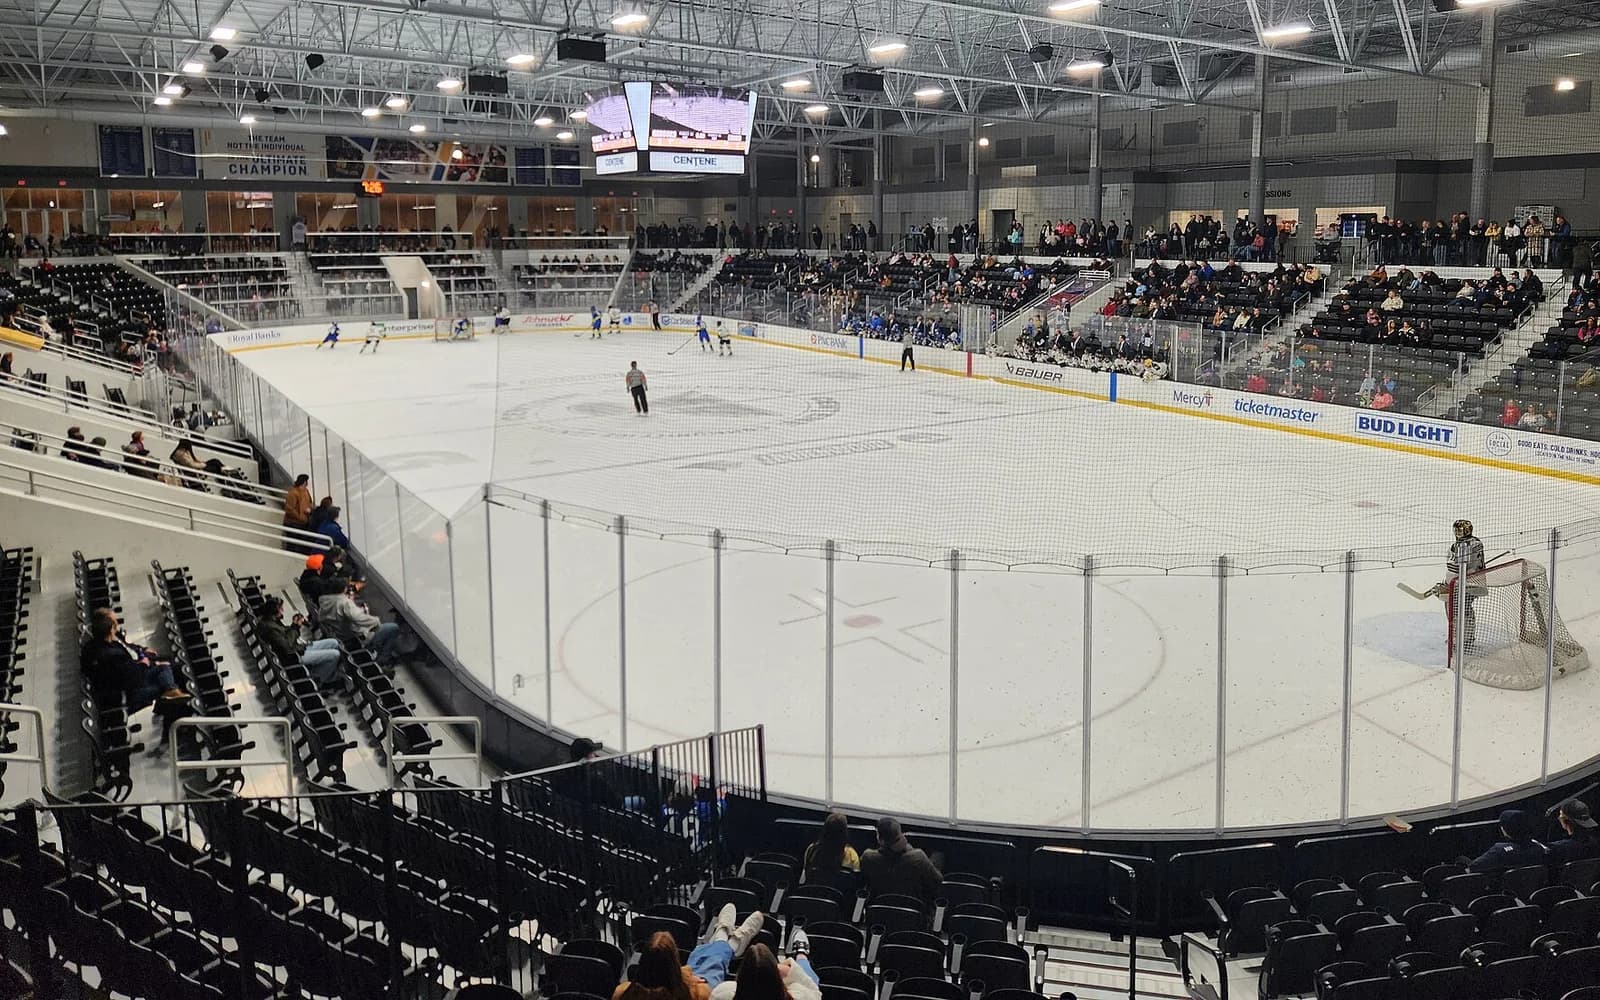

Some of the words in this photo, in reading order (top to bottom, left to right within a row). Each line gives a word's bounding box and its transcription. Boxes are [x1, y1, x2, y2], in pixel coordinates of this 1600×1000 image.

[264, 135, 285, 143] TEAM
[261, 143, 305, 152] INDIVIDUAL
[252, 155, 306, 165] ULTIMATE
[673, 155, 717, 167] CENTENE
[228, 163, 307, 176] CHAMPION
[1243, 189, 1292, 199] CSSIONS
[232, 332, 254, 344] Royal
[255, 329, 281, 341] Banks
[1173, 390, 1205, 408] Mercy
[1234, 398, 1319, 424] ticketmaster
[1358, 416, 1396, 434] BUD
[1398, 421, 1453, 443] LIGHT
[1517, 439, 1533, 448] GOOD
[1551, 444, 1565, 453] COLD
